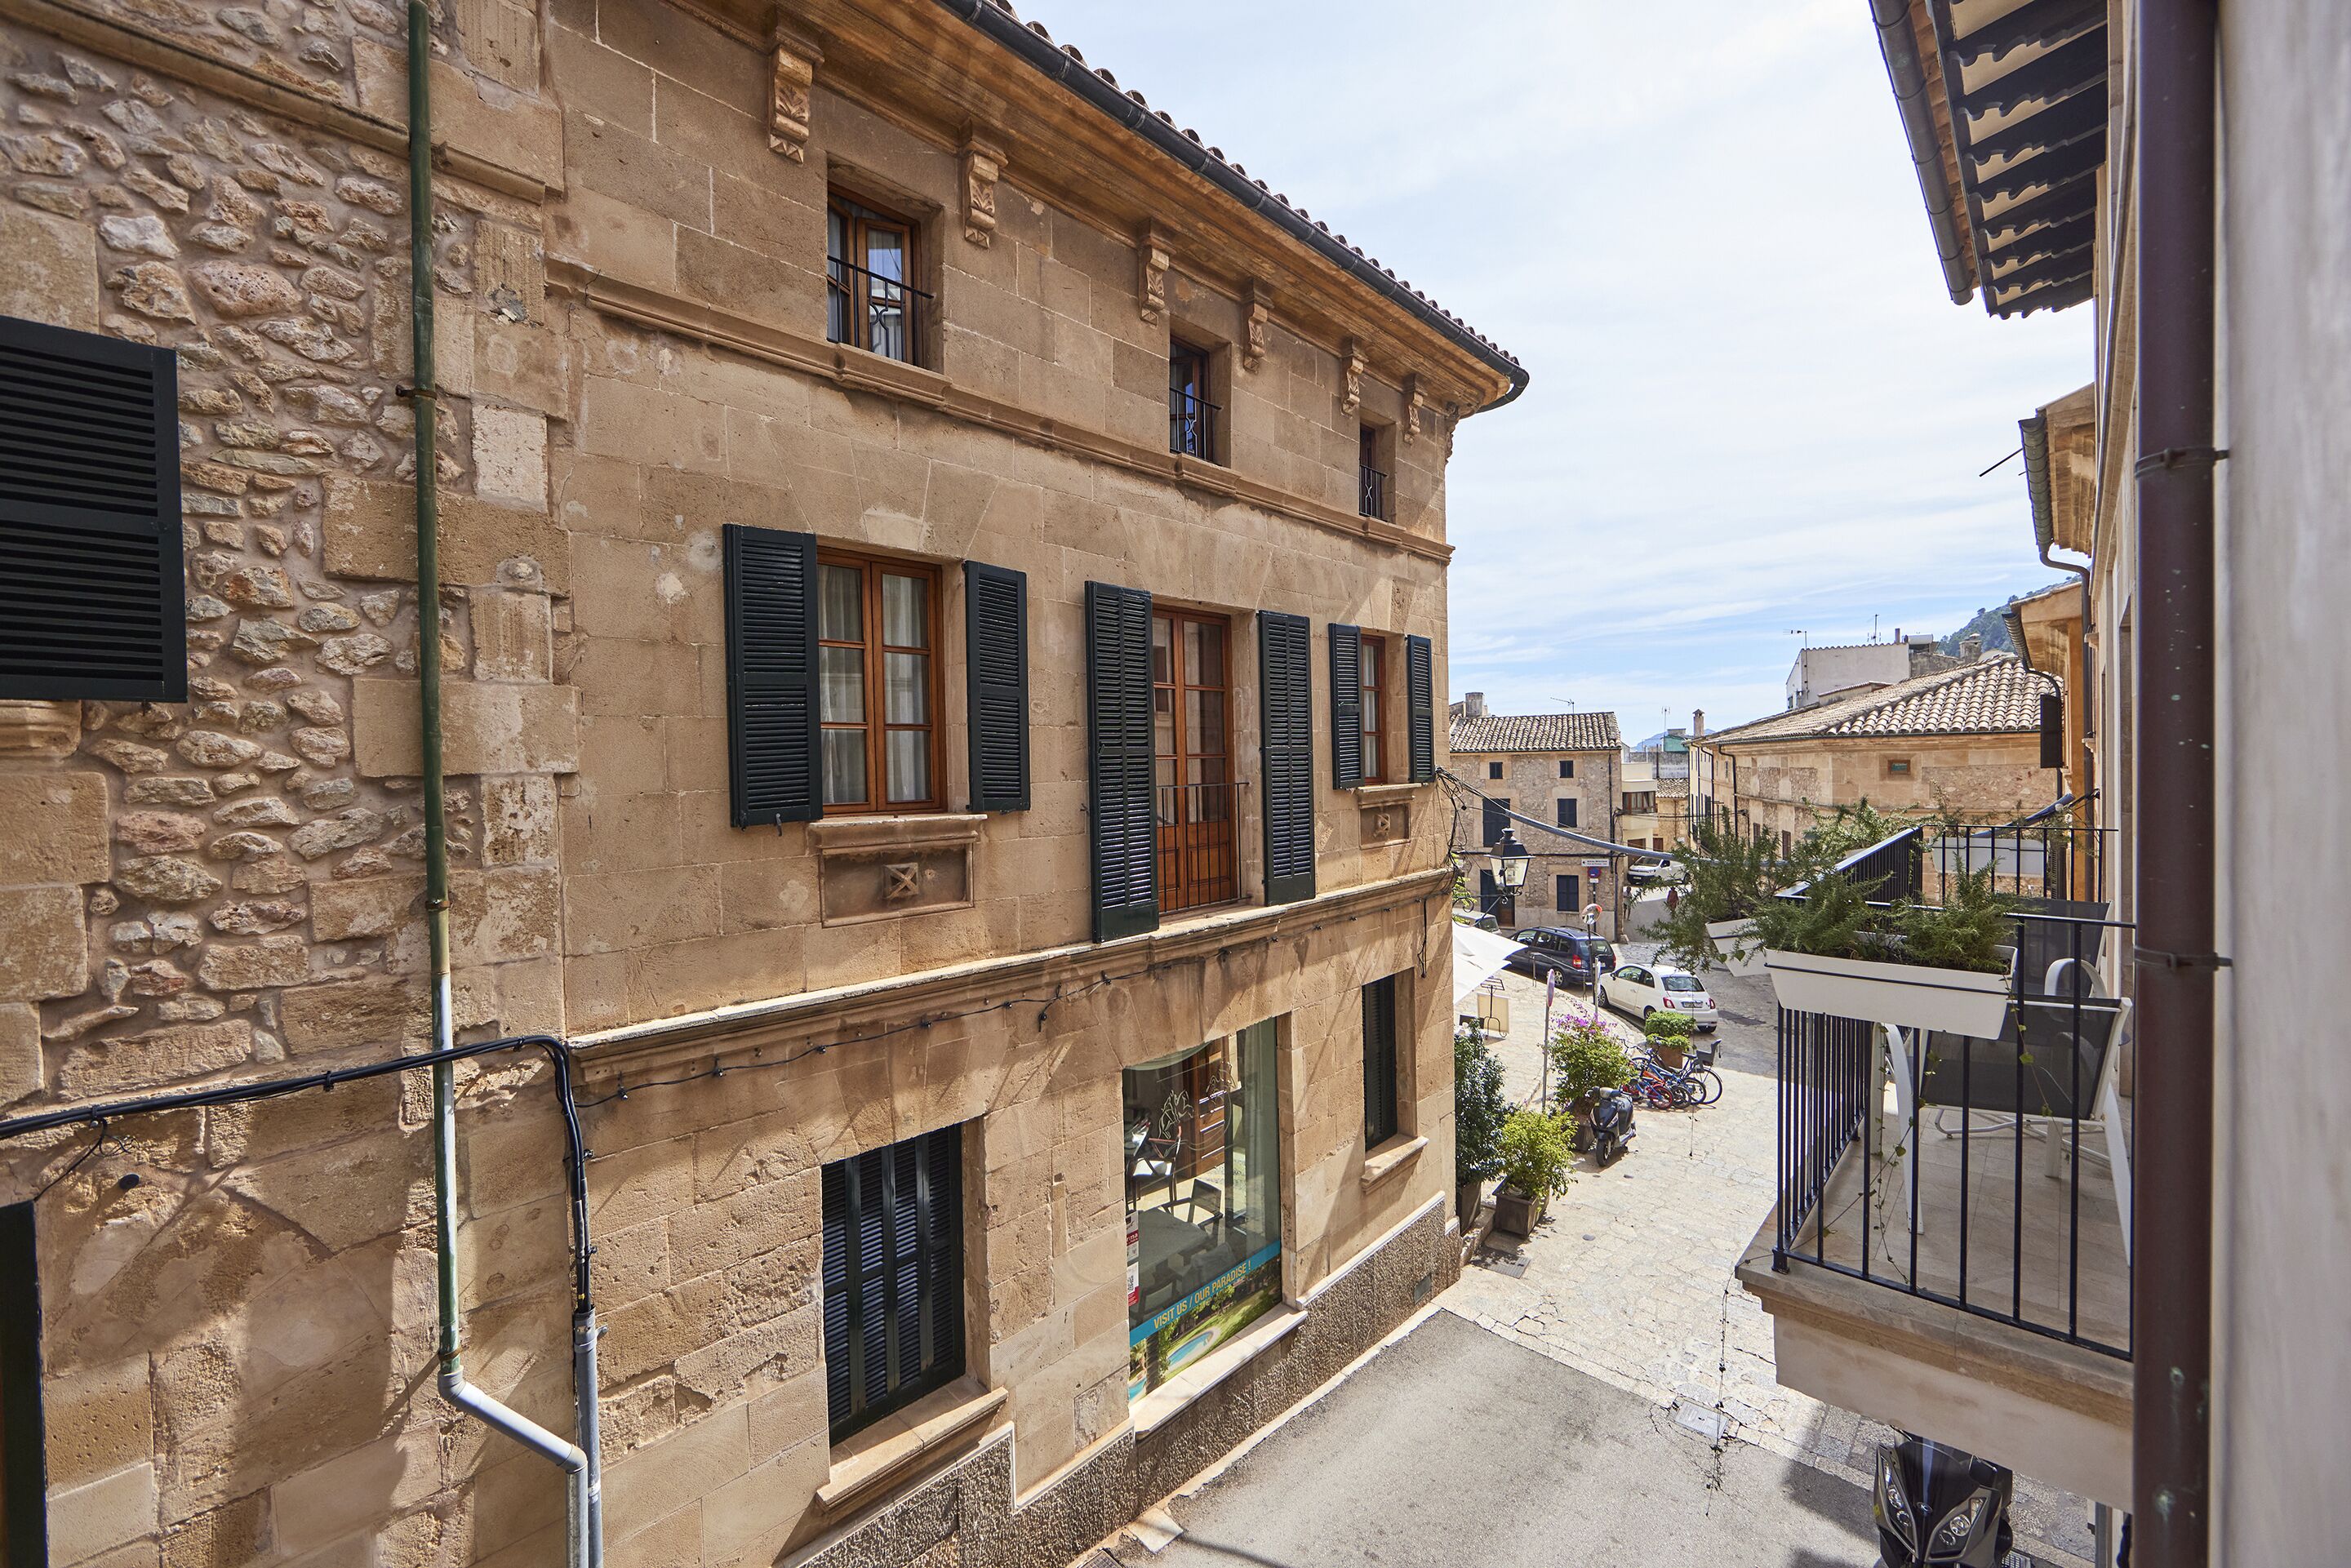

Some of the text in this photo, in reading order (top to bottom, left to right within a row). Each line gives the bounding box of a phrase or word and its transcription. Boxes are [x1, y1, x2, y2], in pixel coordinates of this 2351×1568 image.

[1153, 1259, 1251, 1329] VISIT US / OUR PARADISE !
